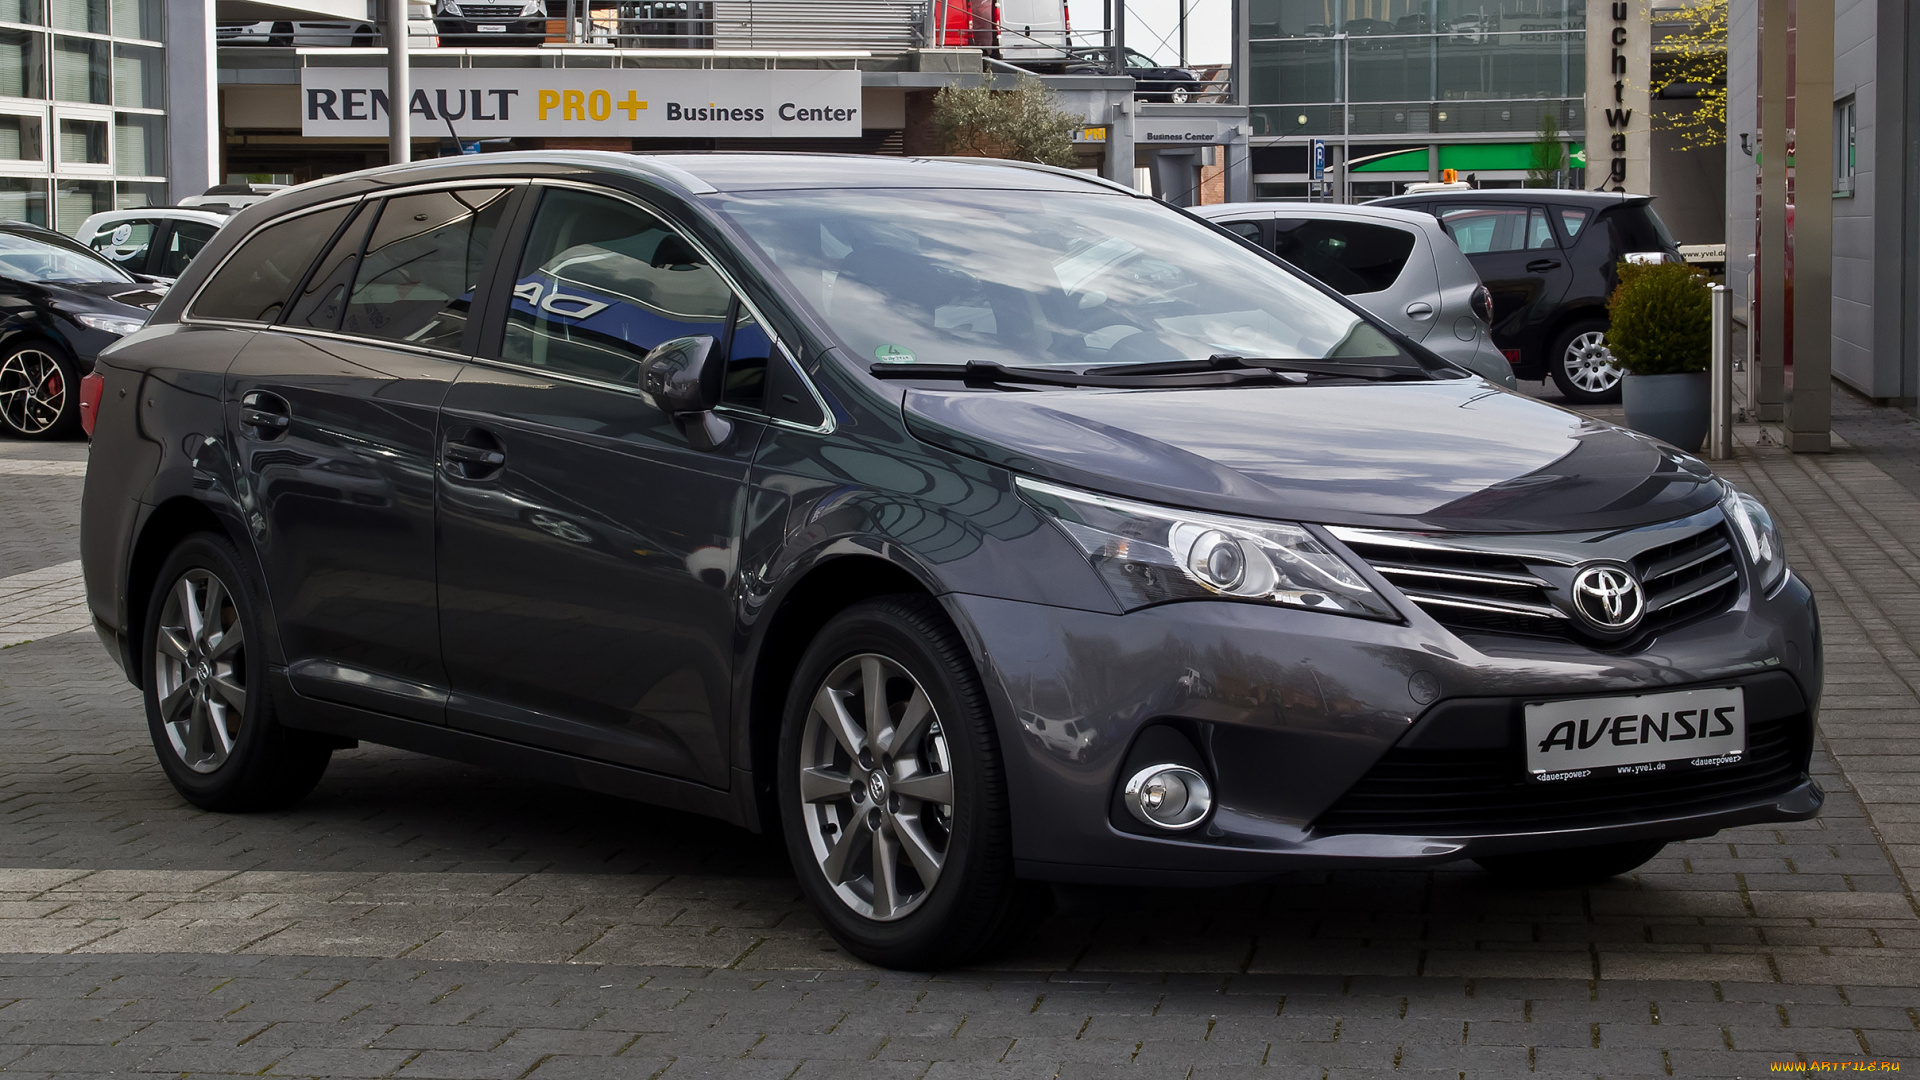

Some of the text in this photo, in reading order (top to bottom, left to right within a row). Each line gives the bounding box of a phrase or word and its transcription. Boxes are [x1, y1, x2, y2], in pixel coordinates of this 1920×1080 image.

[306, 88, 857, 122] RENAULT PRO+ Business Center
[1146, 132, 1215, 141] Business Center
[1537, 706, 1736, 753] AVENSIS
[1617, 762, 1666, 775] www.yvel.de
